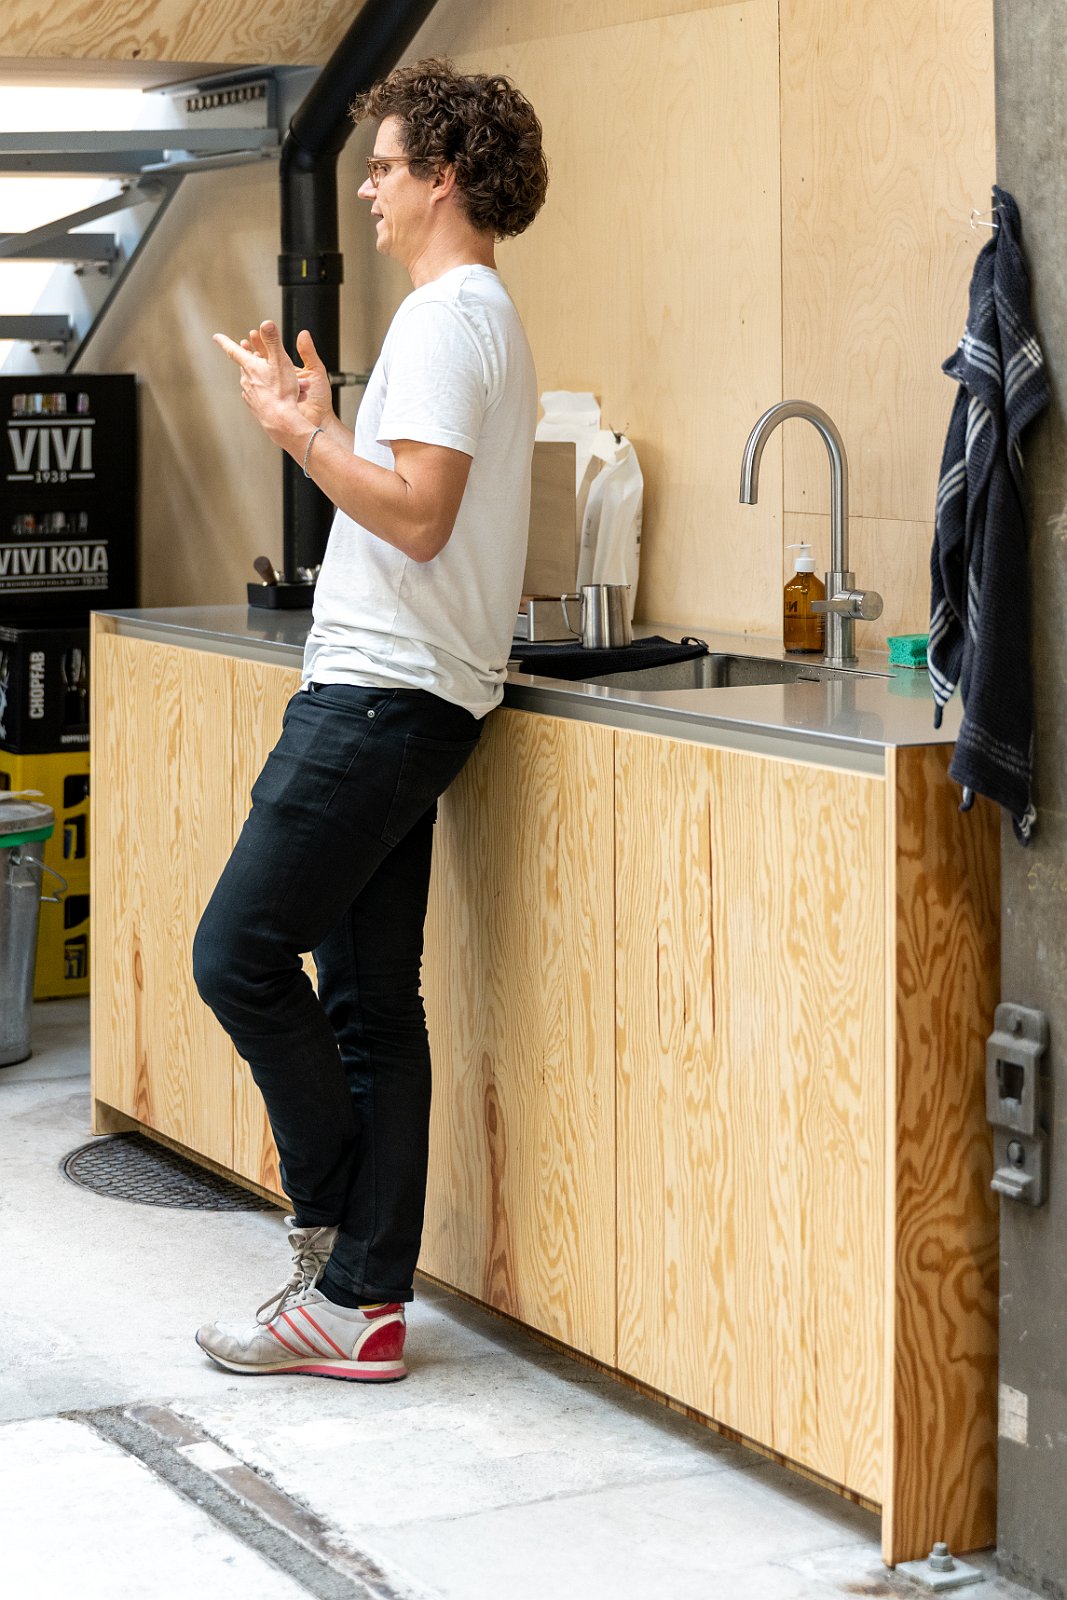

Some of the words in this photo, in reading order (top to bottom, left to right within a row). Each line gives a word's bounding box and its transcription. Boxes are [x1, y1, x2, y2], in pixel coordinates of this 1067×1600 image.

[8, 428, 92, 471] VIVI
[35, 471, 67, 483] 1938
[0, 548, 46, 575] VIVI
[51, 546, 108, 573] KOLA
[29, 651, 45, 719] CHOPFAB
